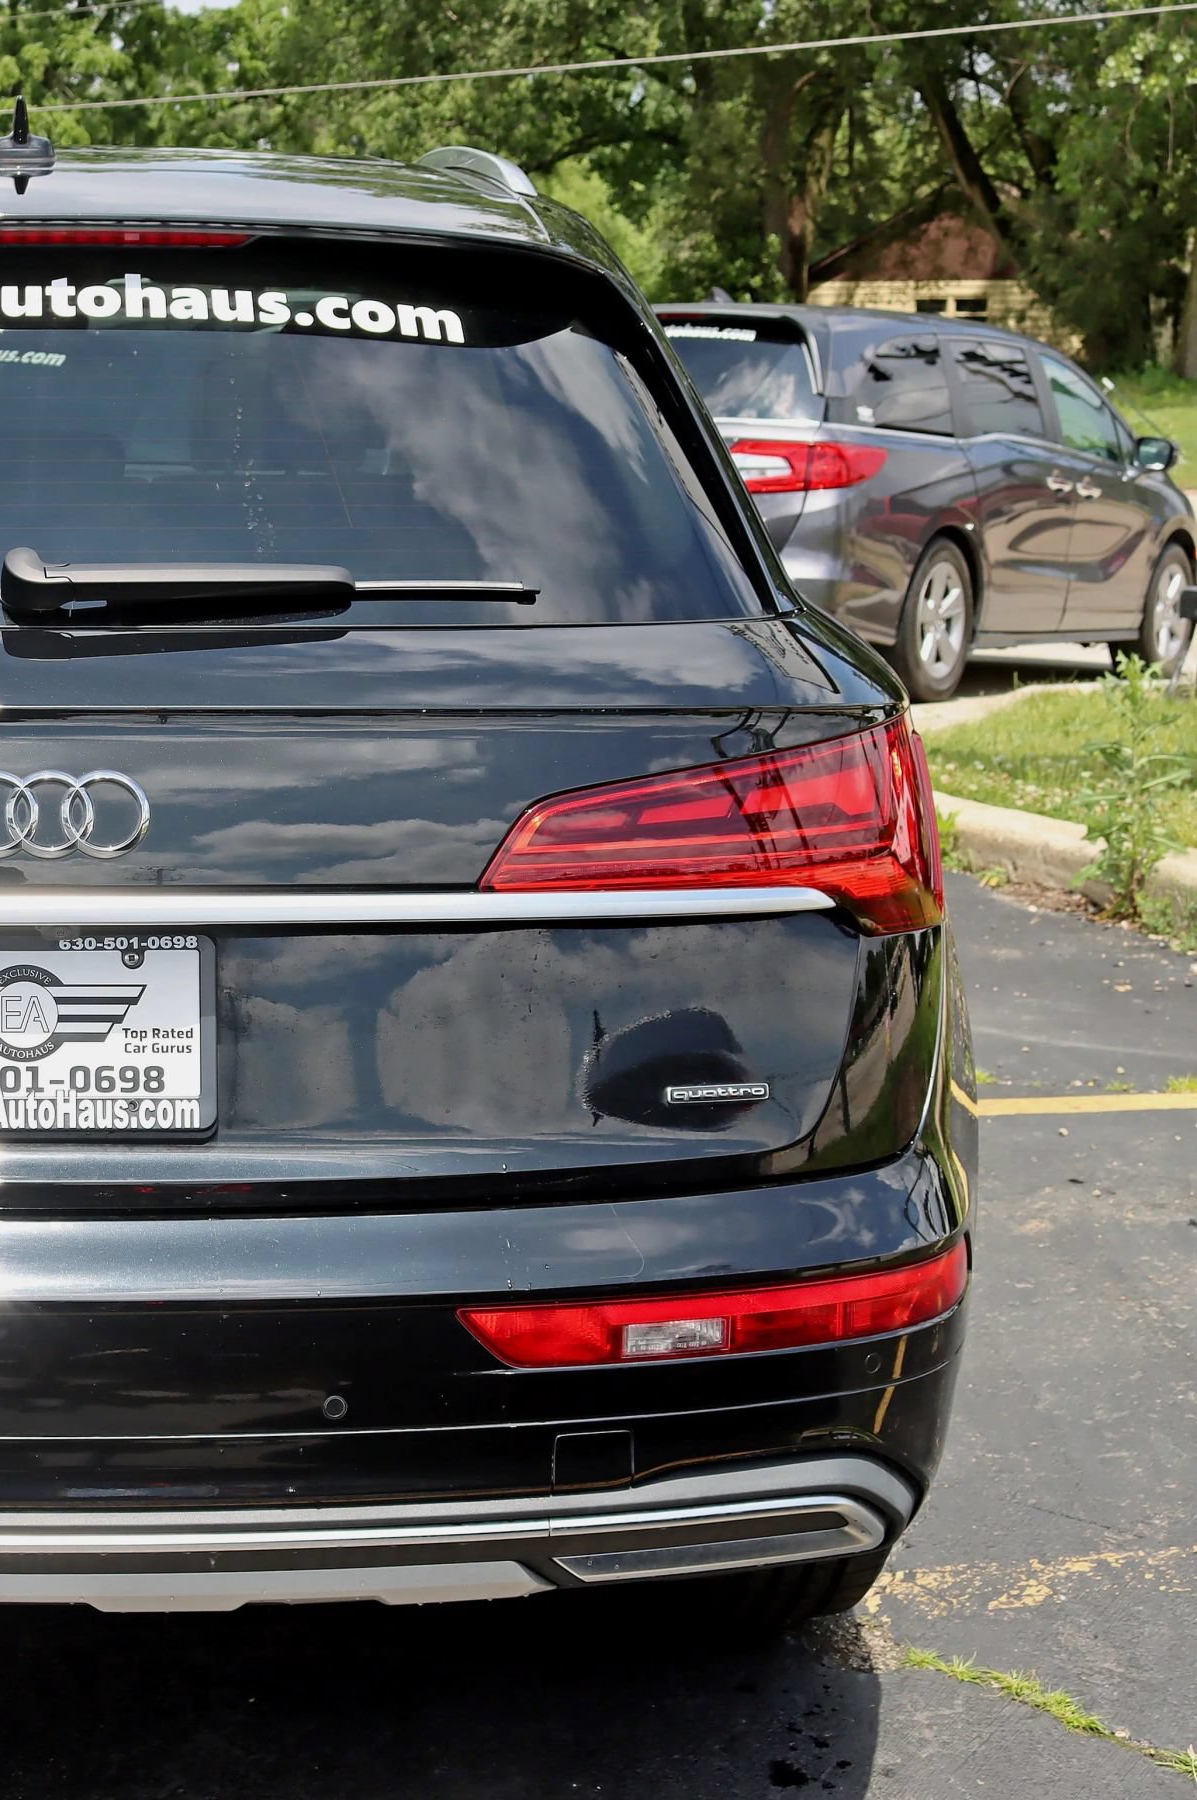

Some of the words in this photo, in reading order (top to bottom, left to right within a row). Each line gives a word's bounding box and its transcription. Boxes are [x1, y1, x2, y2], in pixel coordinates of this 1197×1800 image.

[58, 935, 198, 950] 630-501-0698
[0, 995, 50, 1034] EA
[122, 1027, 148, 1041] Top
[152, 1027, 194, 1040] Rated
[124, 1042, 148, 1054] Car
[153, 1042, 193, 1054] Gurus
[673, 1086, 765, 1101] quattro
